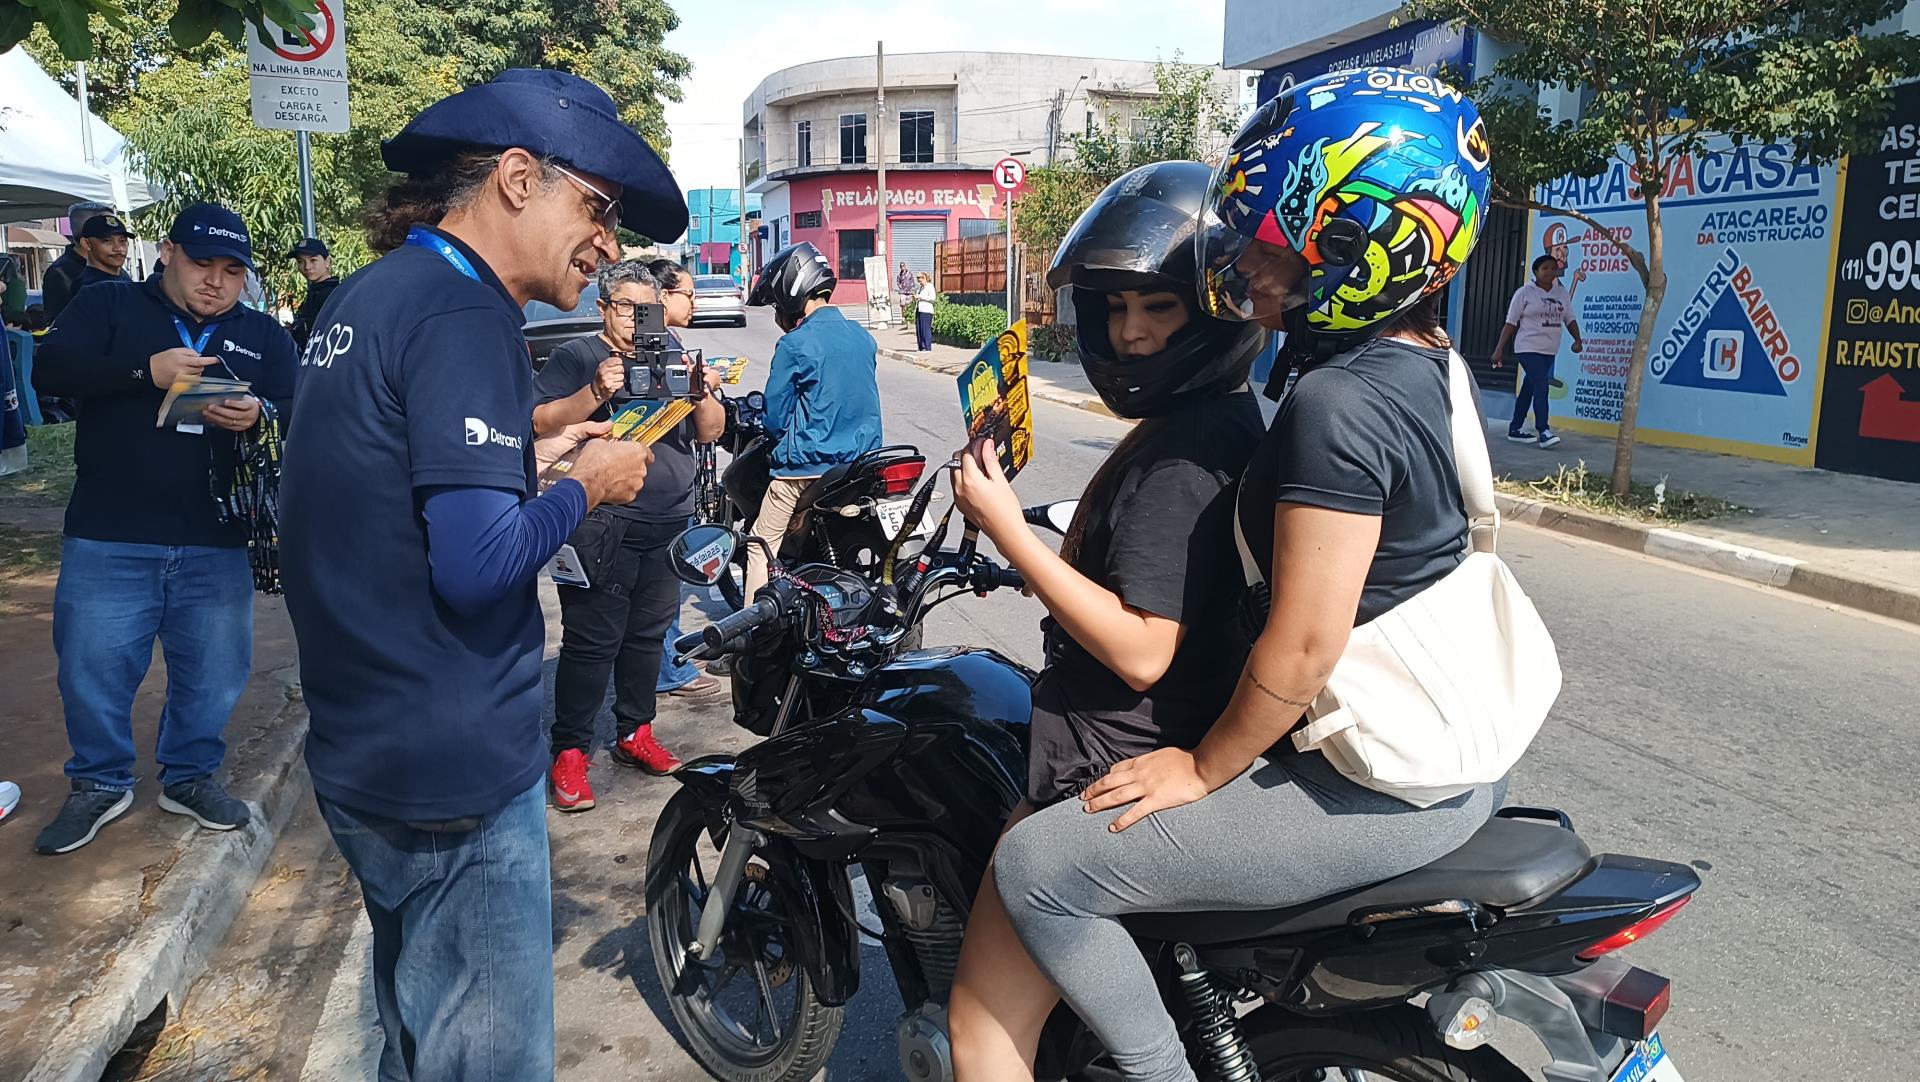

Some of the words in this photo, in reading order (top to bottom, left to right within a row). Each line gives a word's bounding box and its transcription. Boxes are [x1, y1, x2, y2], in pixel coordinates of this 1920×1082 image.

[1361, 45, 1393, 67] JANELAS
[1394, 41, 1408, 58] EM
[253, 63, 267, 73] NA
[270, 64, 300, 75] LINHA
[303, 67, 343, 78] BRANCA
[281, 85, 319, 97] EXCETO
[280, 101, 313, 111] CARGA
[316, 103, 322, 112] E
[275, 111, 328, 123] DESCARGA
[1003, 165, 1015, 184] E
[1547, 163, 1626, 208] PARA
[1698, 143, 1820, 194] CASA
[932, 189, 978, 206] REAL
[1701, 204, 1828, 231] ATACAREJO
[1697, 232, 1715, 245] DA
[1717, 225, 1825, 244] CONSTRUÇÃO
[1581, 243, 1628, 256] TODO
[1580, 259, 1597, 272] OS
[1598, 259, 1629, 272] DIAS
[1650, 247, 1740, 376] CONSTRU
[1730, 265, 1800, 382] BAIRRO
[1594, 321, 1639, 334] 99295-070
[490, 427, 522, 450] Detran.S
